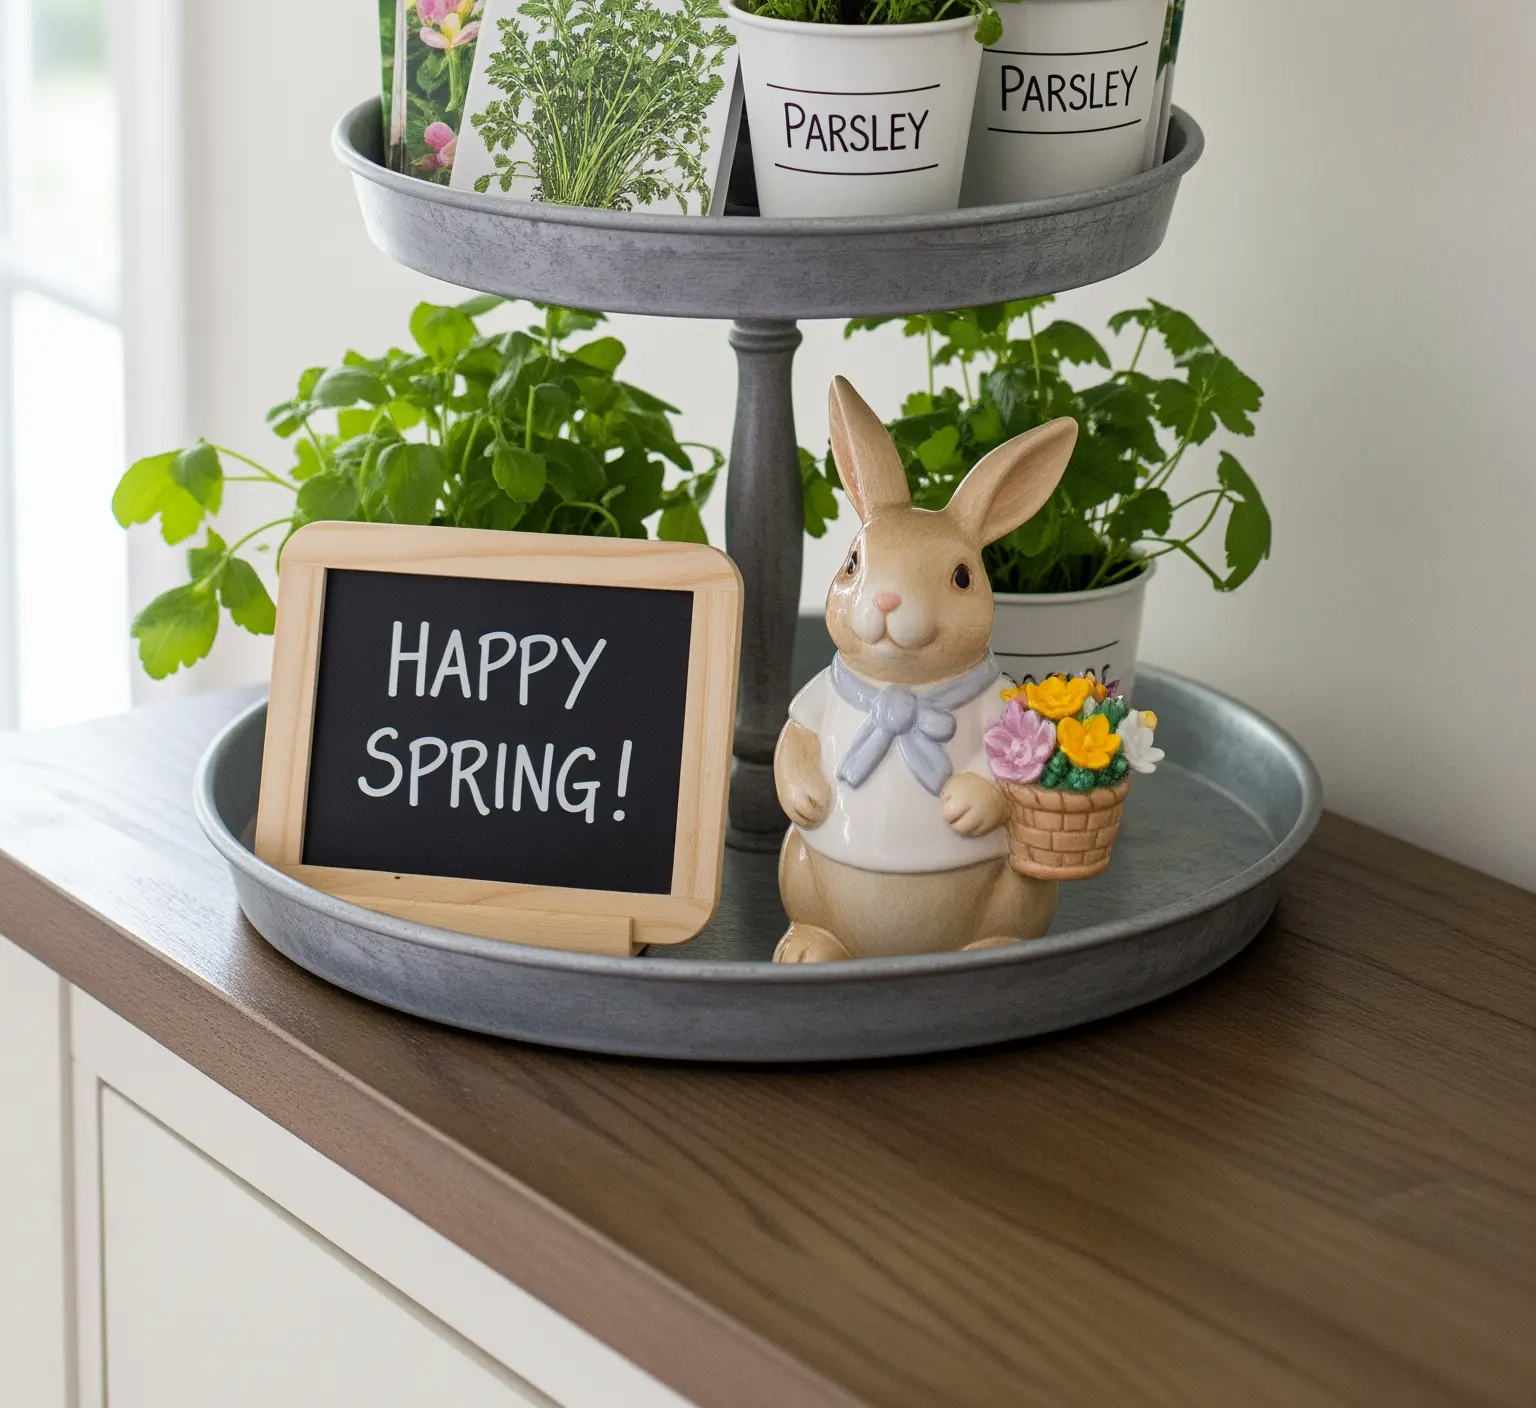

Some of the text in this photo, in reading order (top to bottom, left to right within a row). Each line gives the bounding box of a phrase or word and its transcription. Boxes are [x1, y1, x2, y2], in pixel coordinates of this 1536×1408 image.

[1000, 65, 1139, 112] PARSLEY
[783, 102, 930, 153] PARSLEY
[387, 620, 608, 710] HAPPY
[357, 726, 633, 824] SPRING!
